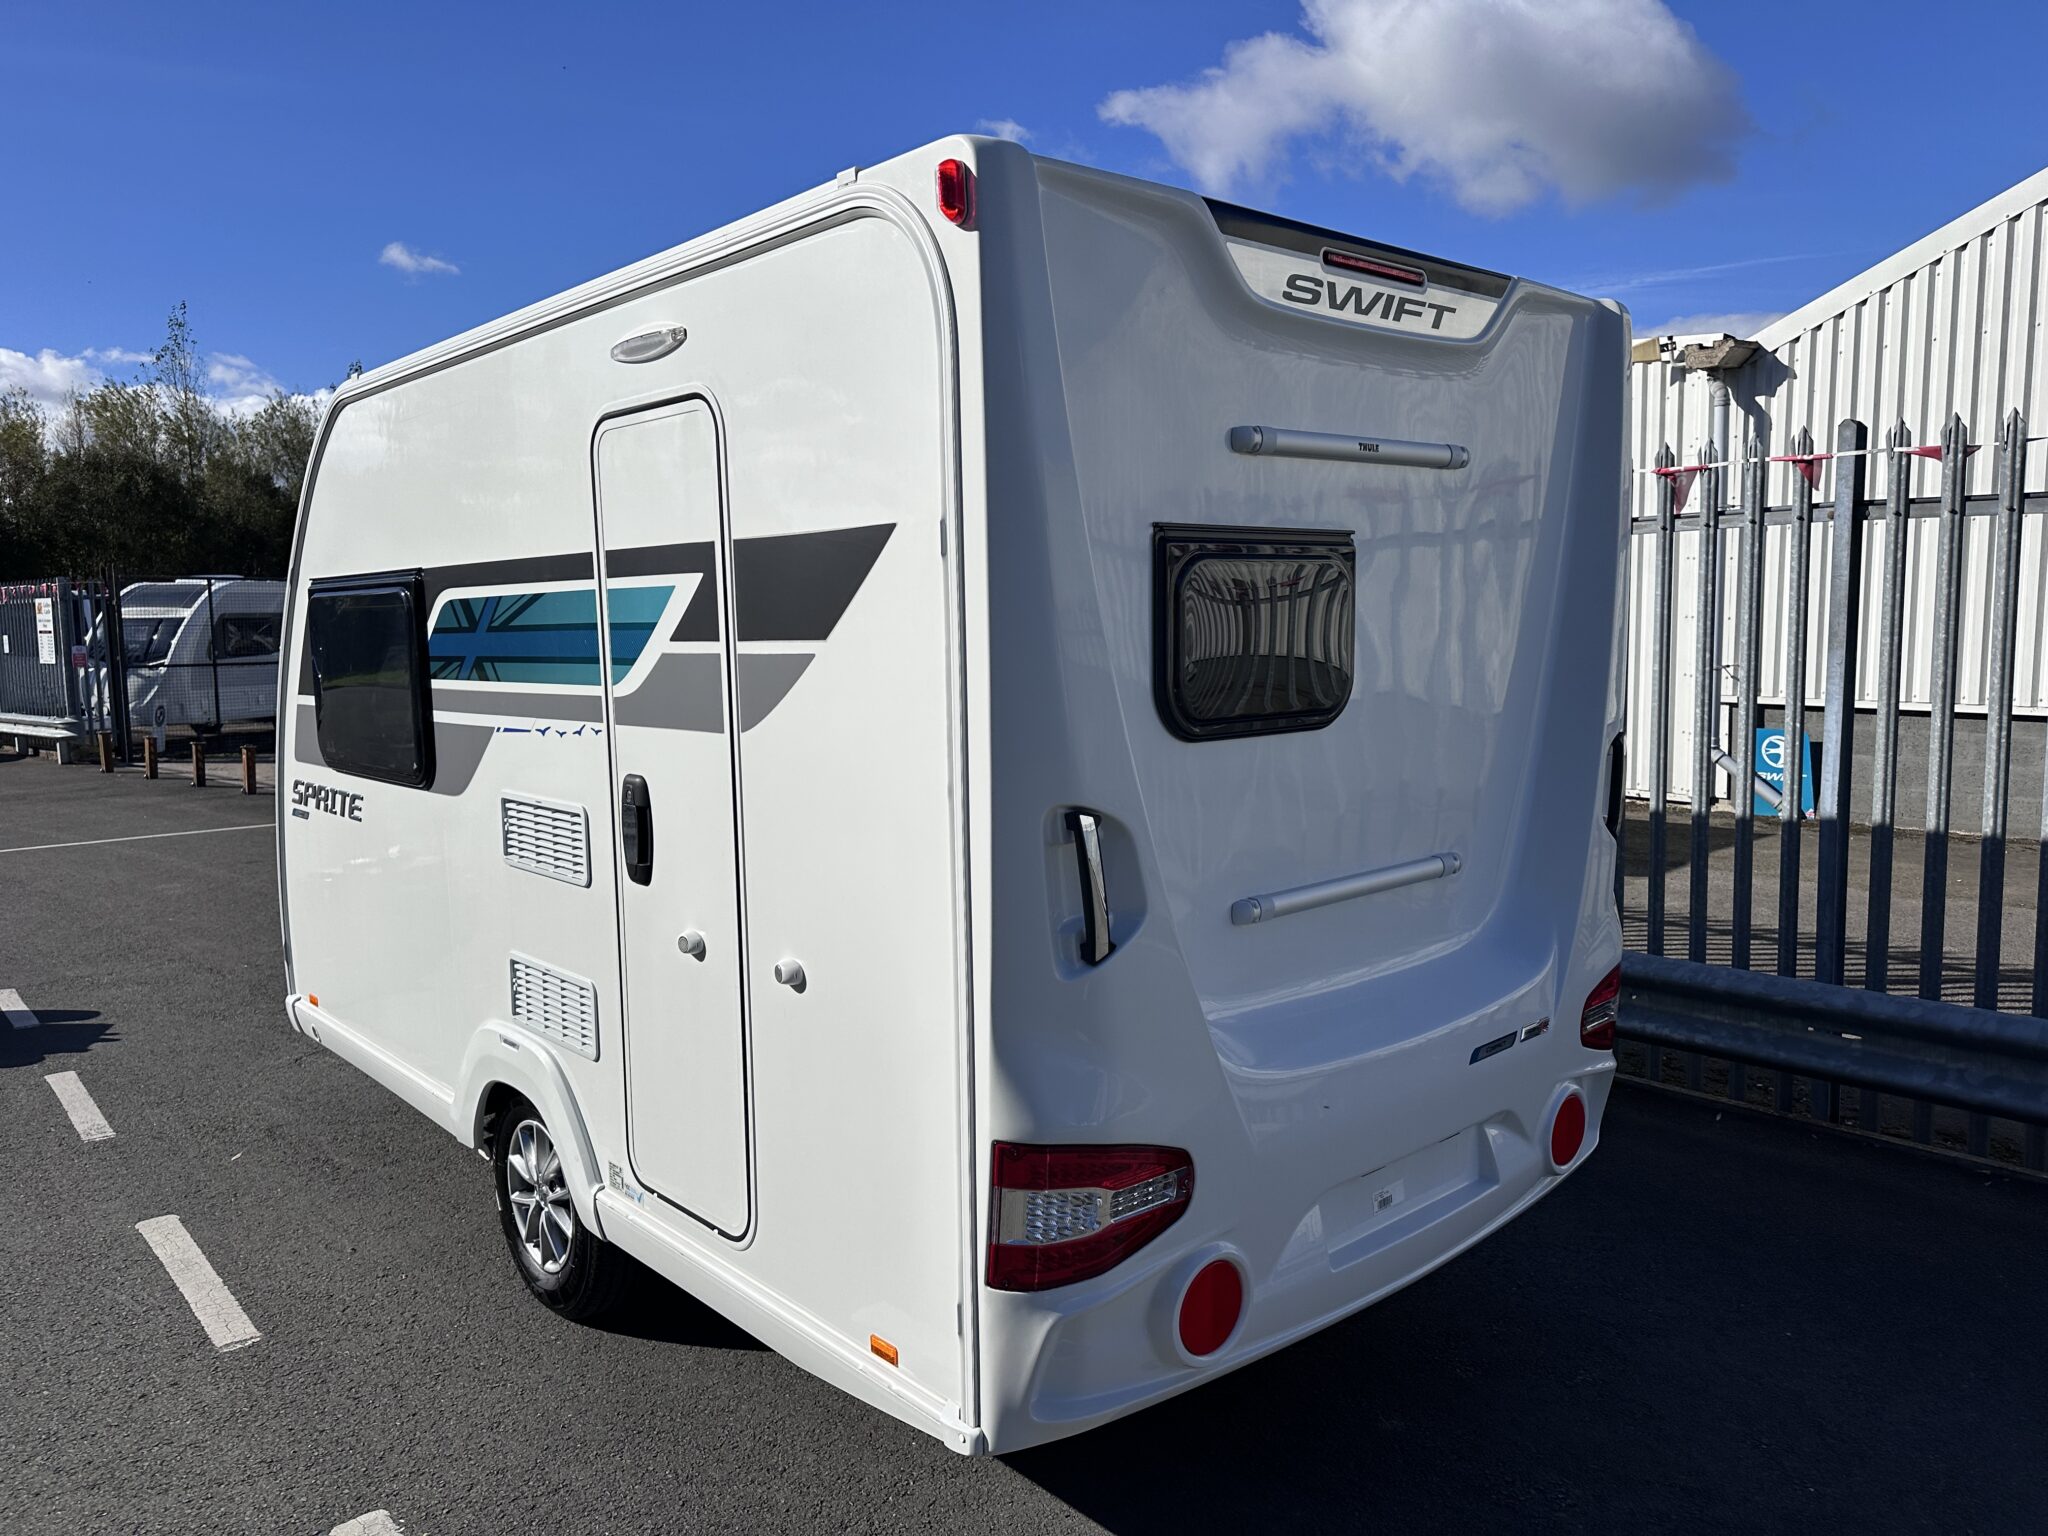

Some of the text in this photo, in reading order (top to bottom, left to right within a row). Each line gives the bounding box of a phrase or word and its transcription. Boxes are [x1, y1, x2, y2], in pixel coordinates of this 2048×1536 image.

[1282, 273, 1457, 330] SWIFT
[1358, 442, 1379, 453] THULE
[291, 779, 364, 822] SPRITE
